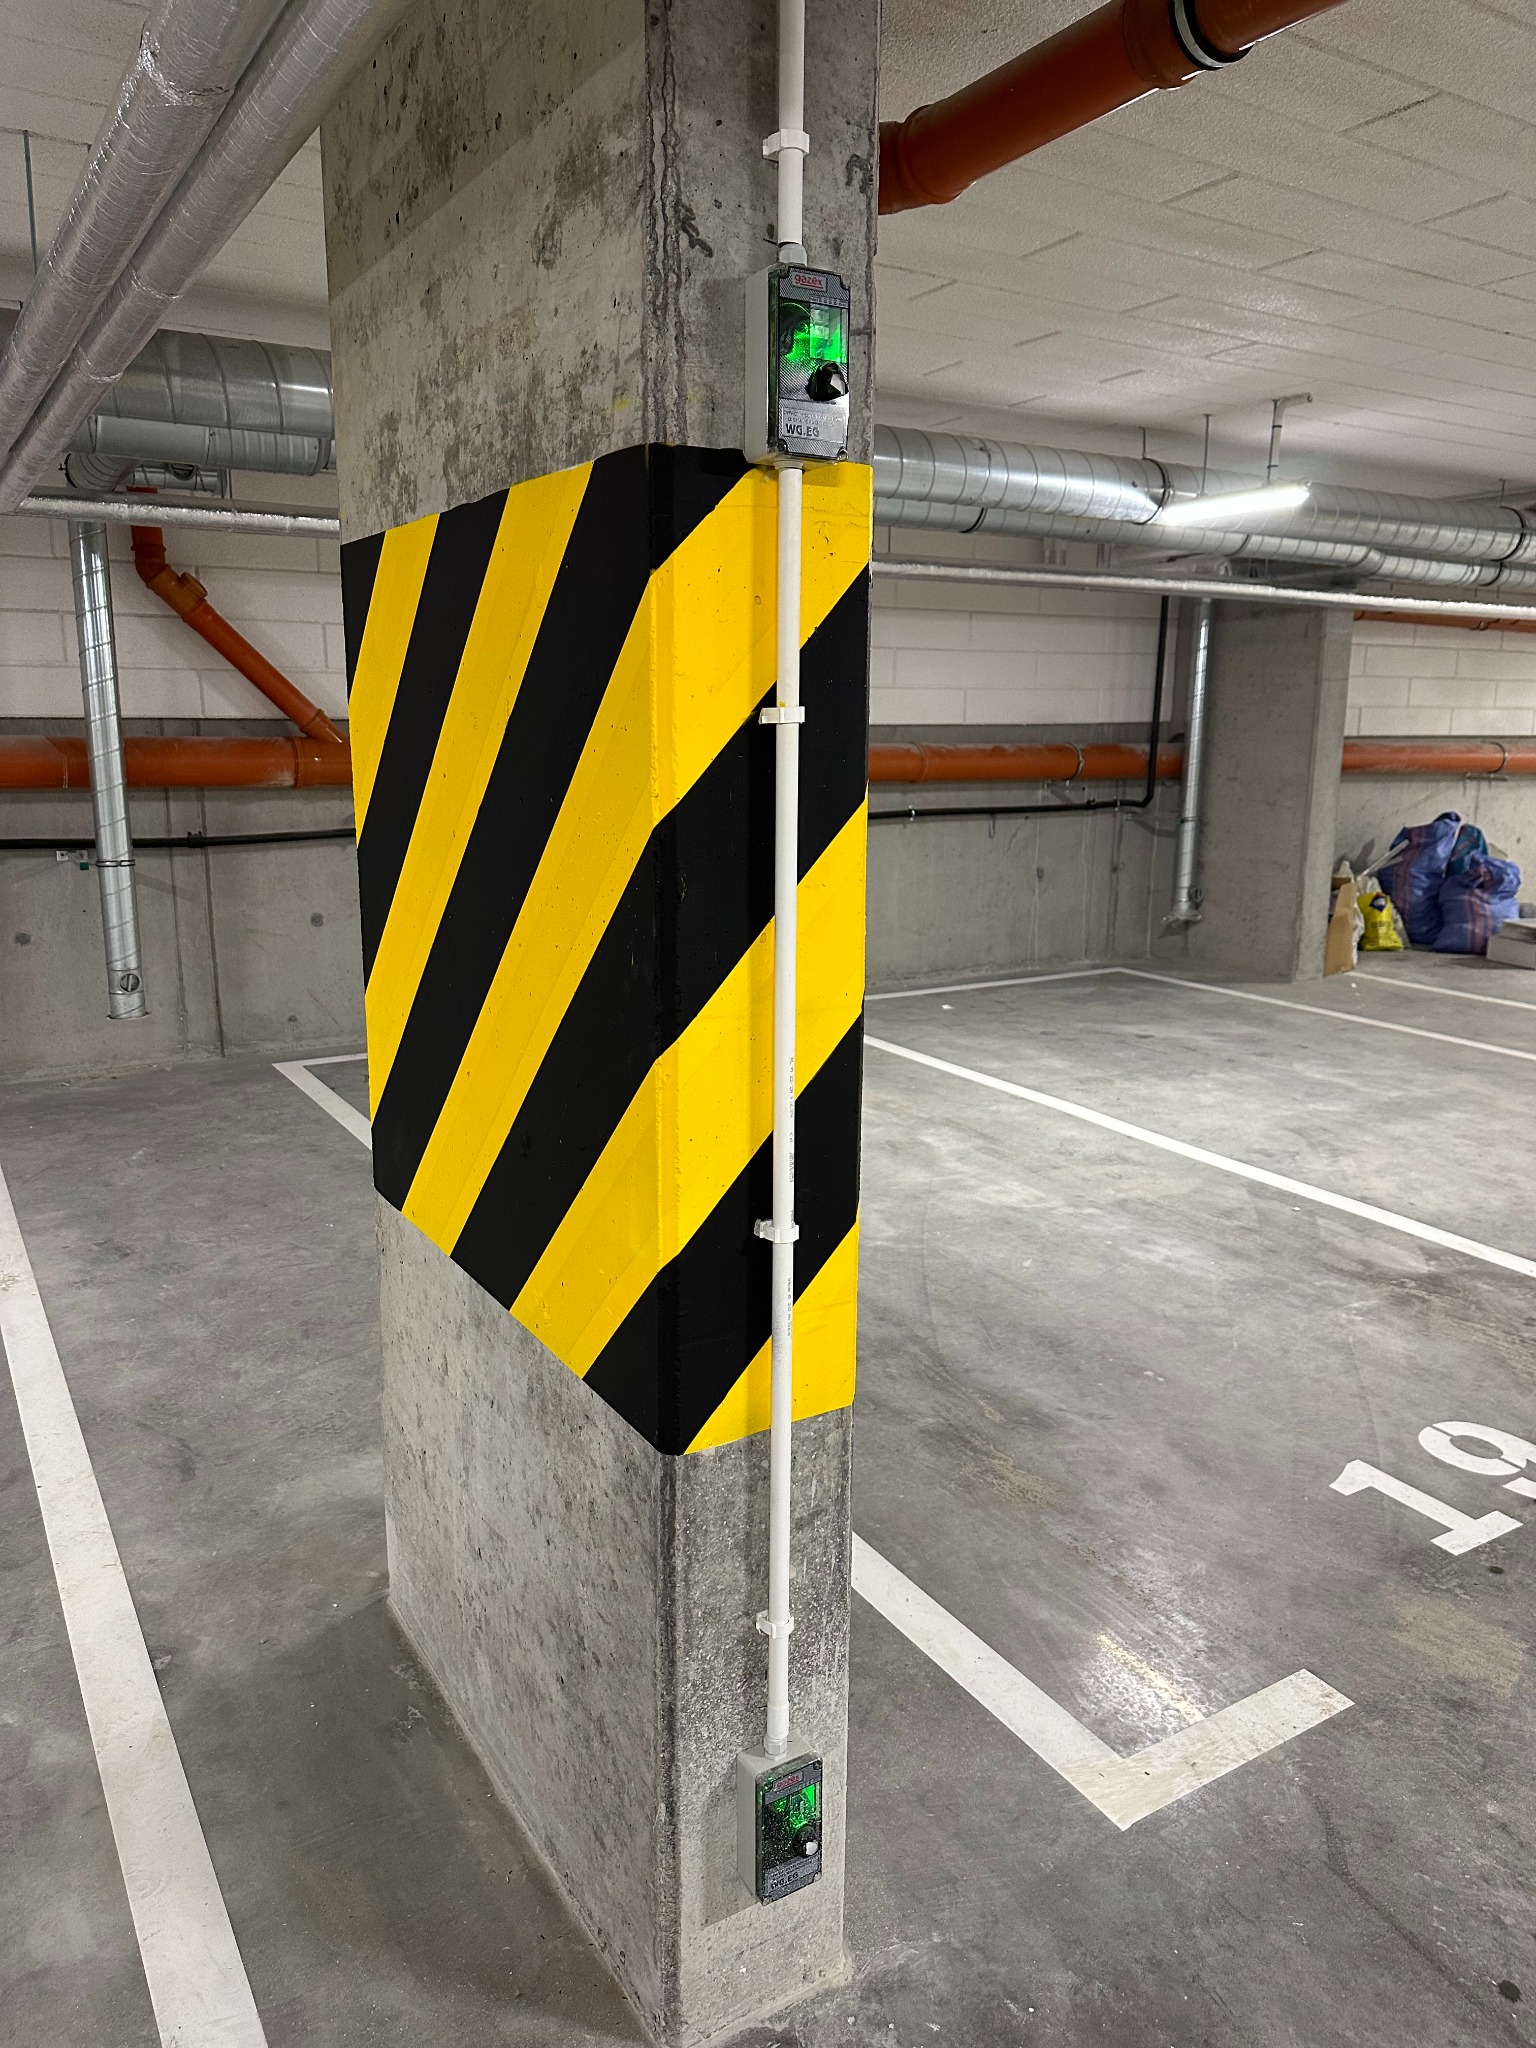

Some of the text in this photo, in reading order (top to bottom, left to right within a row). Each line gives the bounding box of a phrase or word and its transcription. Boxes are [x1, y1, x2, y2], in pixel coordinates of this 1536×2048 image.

[795, 274, 823, 287] gazex
[786, 423, 820, 437] WG.EG
[1329, 1421, 1536, 1556] 19
